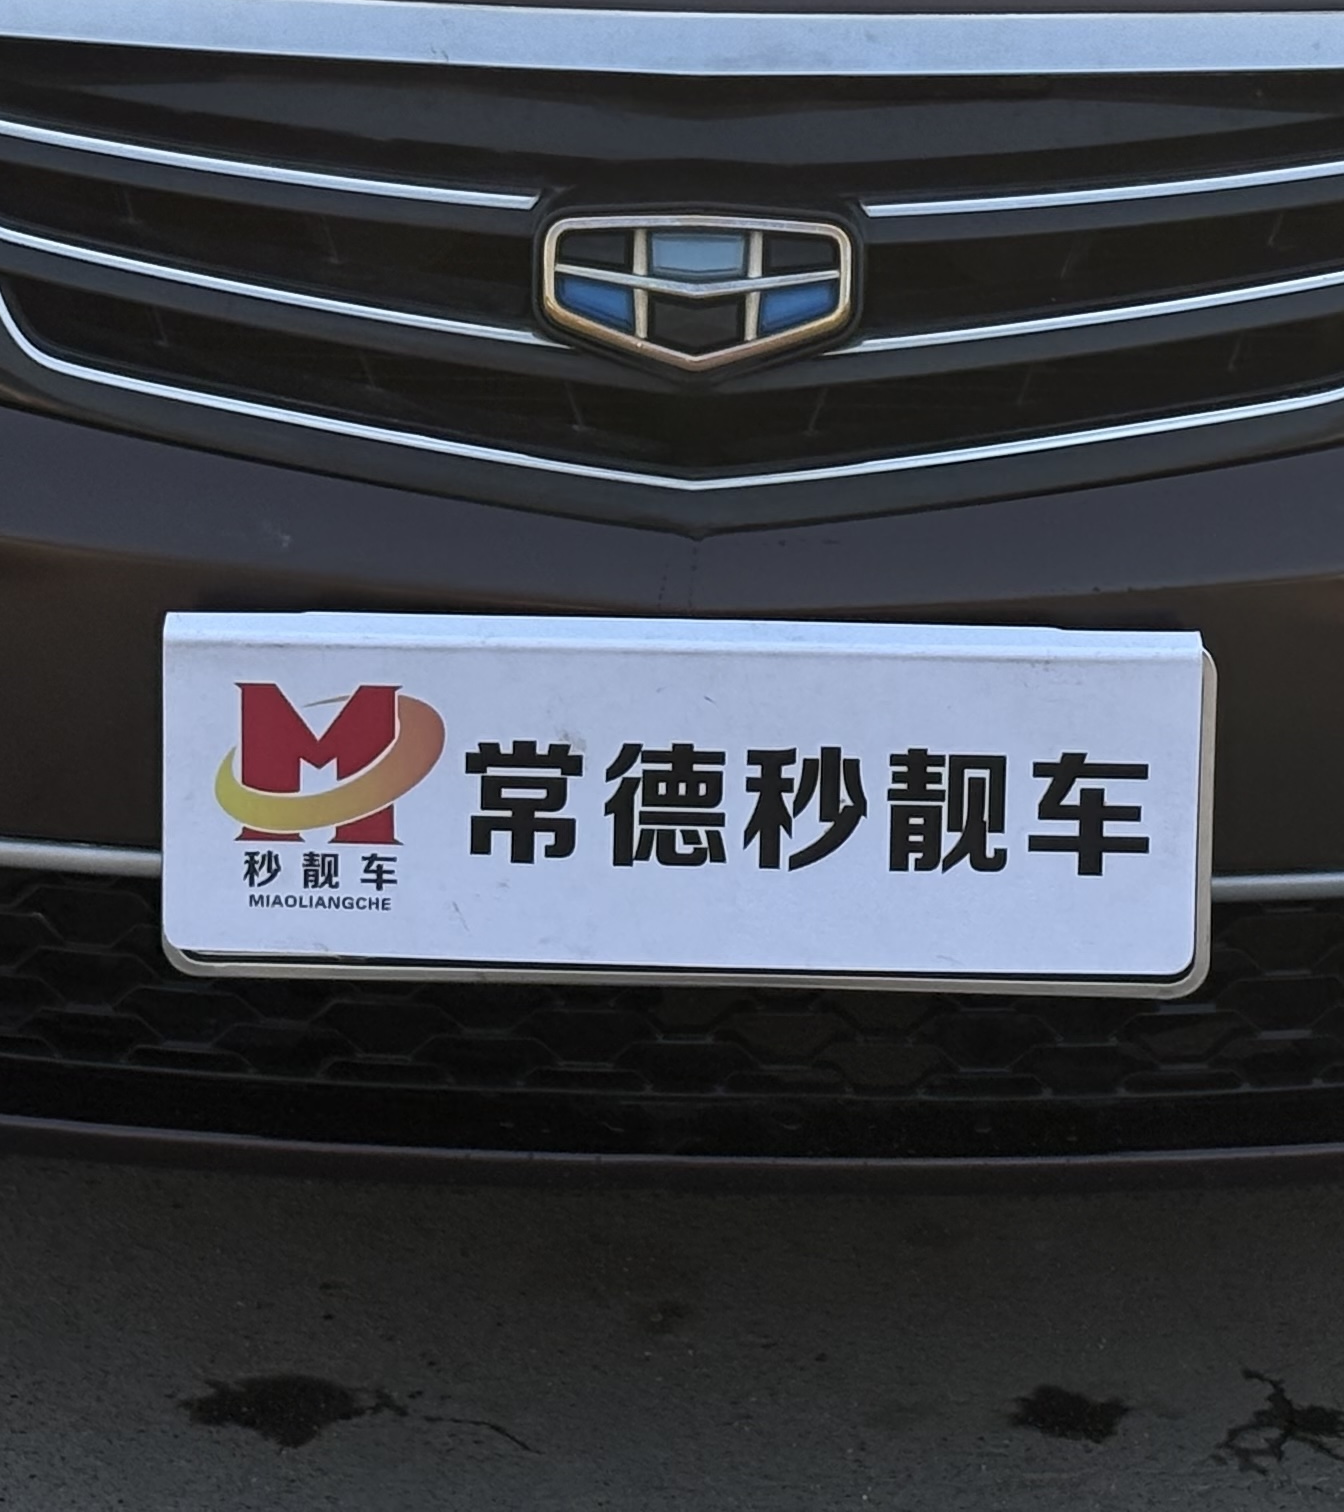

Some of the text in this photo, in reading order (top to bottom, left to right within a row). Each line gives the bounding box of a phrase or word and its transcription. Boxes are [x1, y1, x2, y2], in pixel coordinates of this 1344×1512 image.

[465, 740, 1151, 877] 常德秒靓车
[242, 849, 399, 891] 秒靓车
[248, 893, 392, 912] MIAOLIANGCHE
